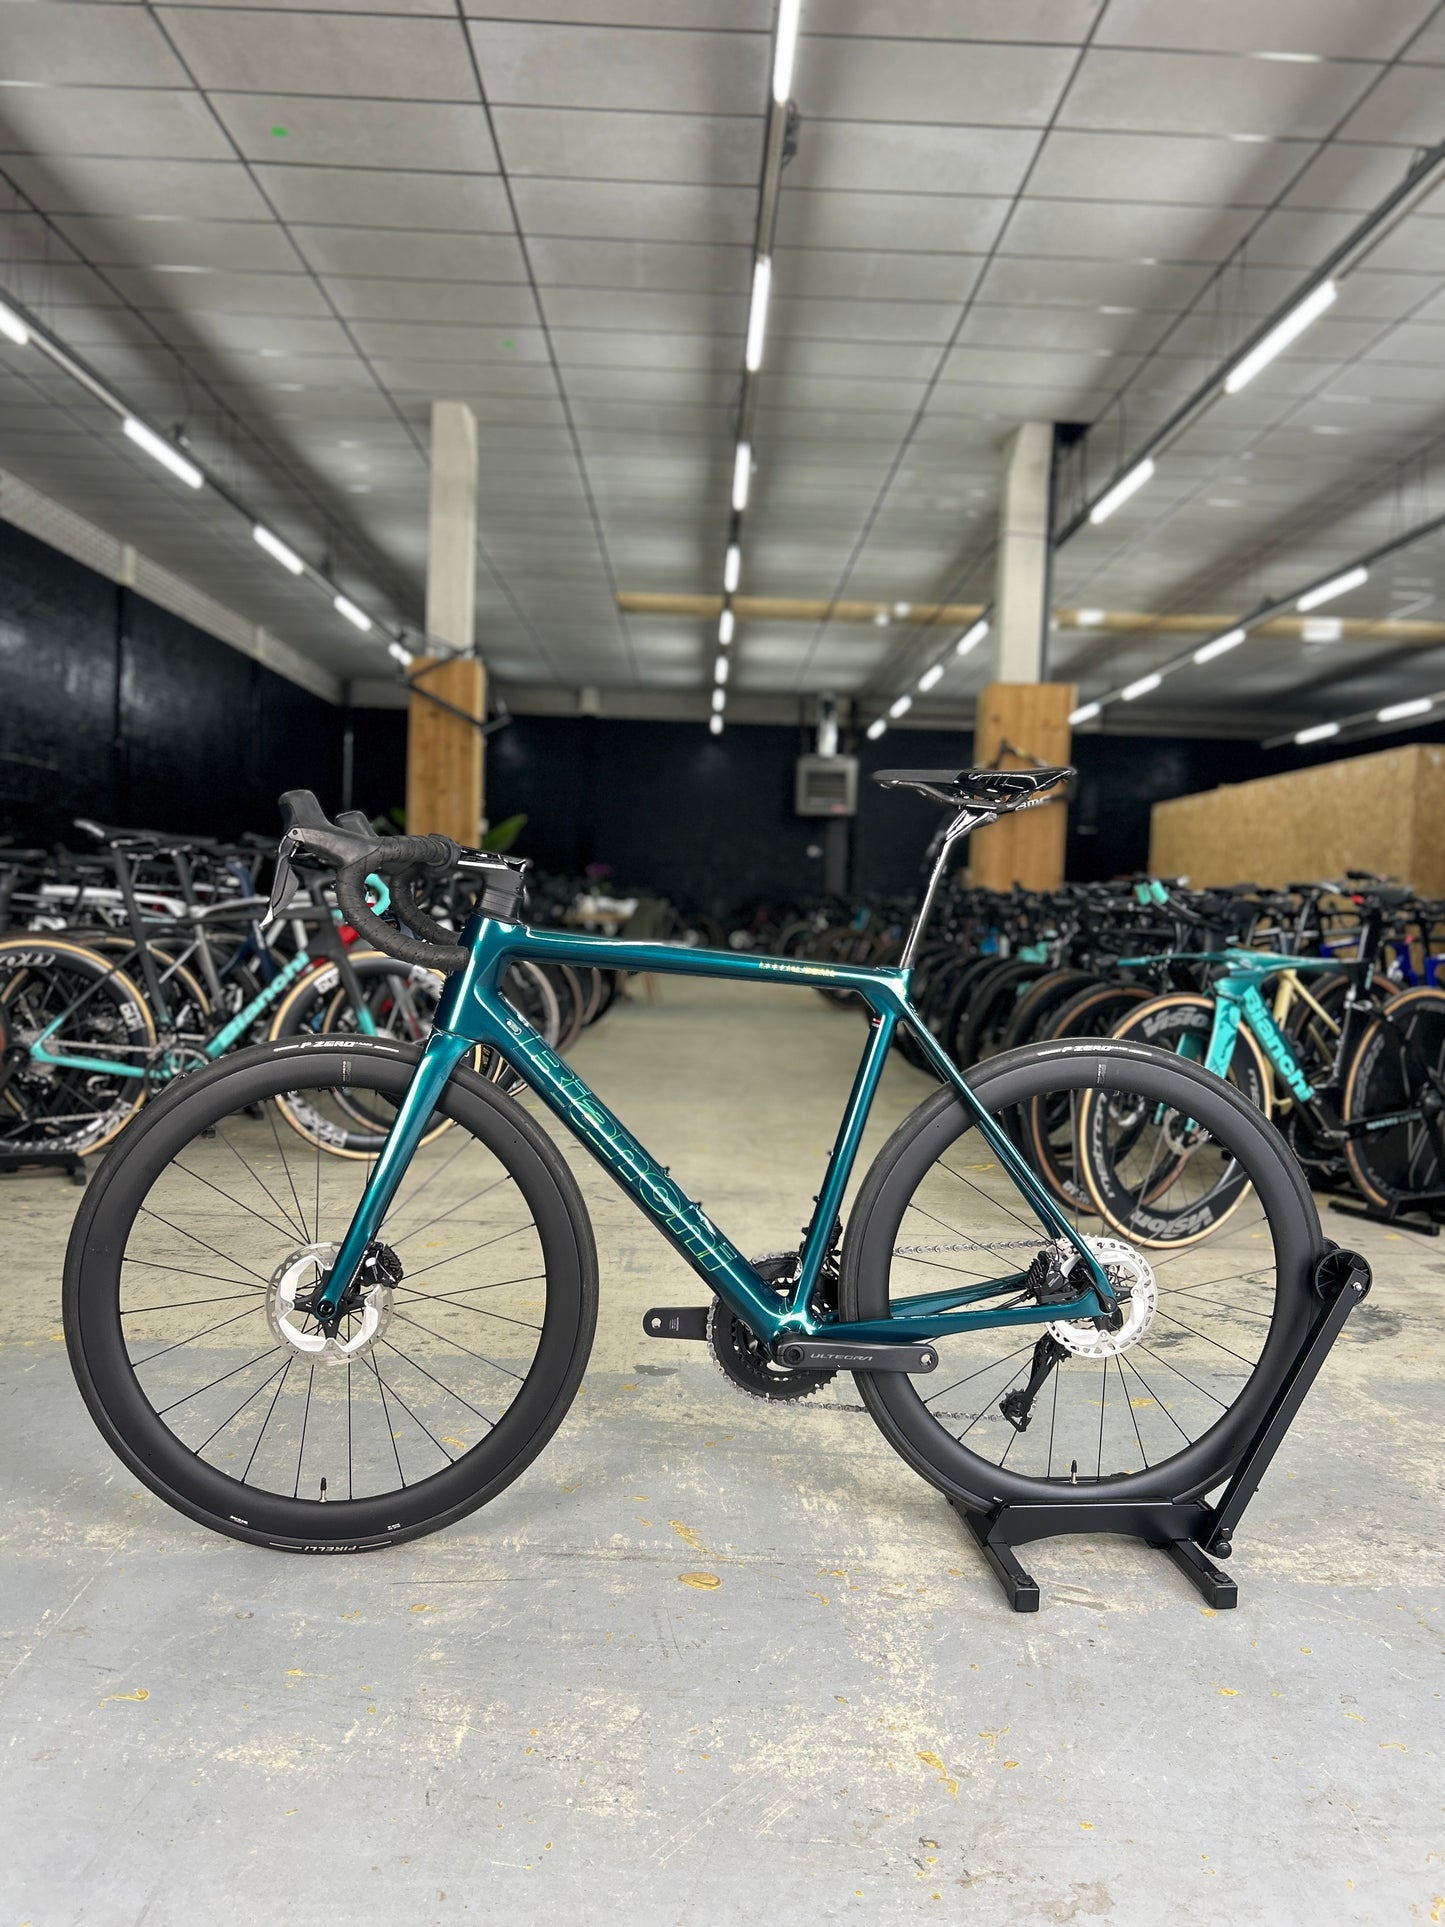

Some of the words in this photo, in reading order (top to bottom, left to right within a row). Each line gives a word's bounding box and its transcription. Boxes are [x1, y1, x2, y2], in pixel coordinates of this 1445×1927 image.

[215, 950, 310, 1048] Bianchi
[1141, 1005, 1211, 1038] Visio
[1243, 986, 1316, 1102] Bianchi
[513, 1035, 738, 1272] Bianchi
[1129, 1205, 1214, 1239] Vision
[810, 1353, 873, 1361] ULTEGRA
